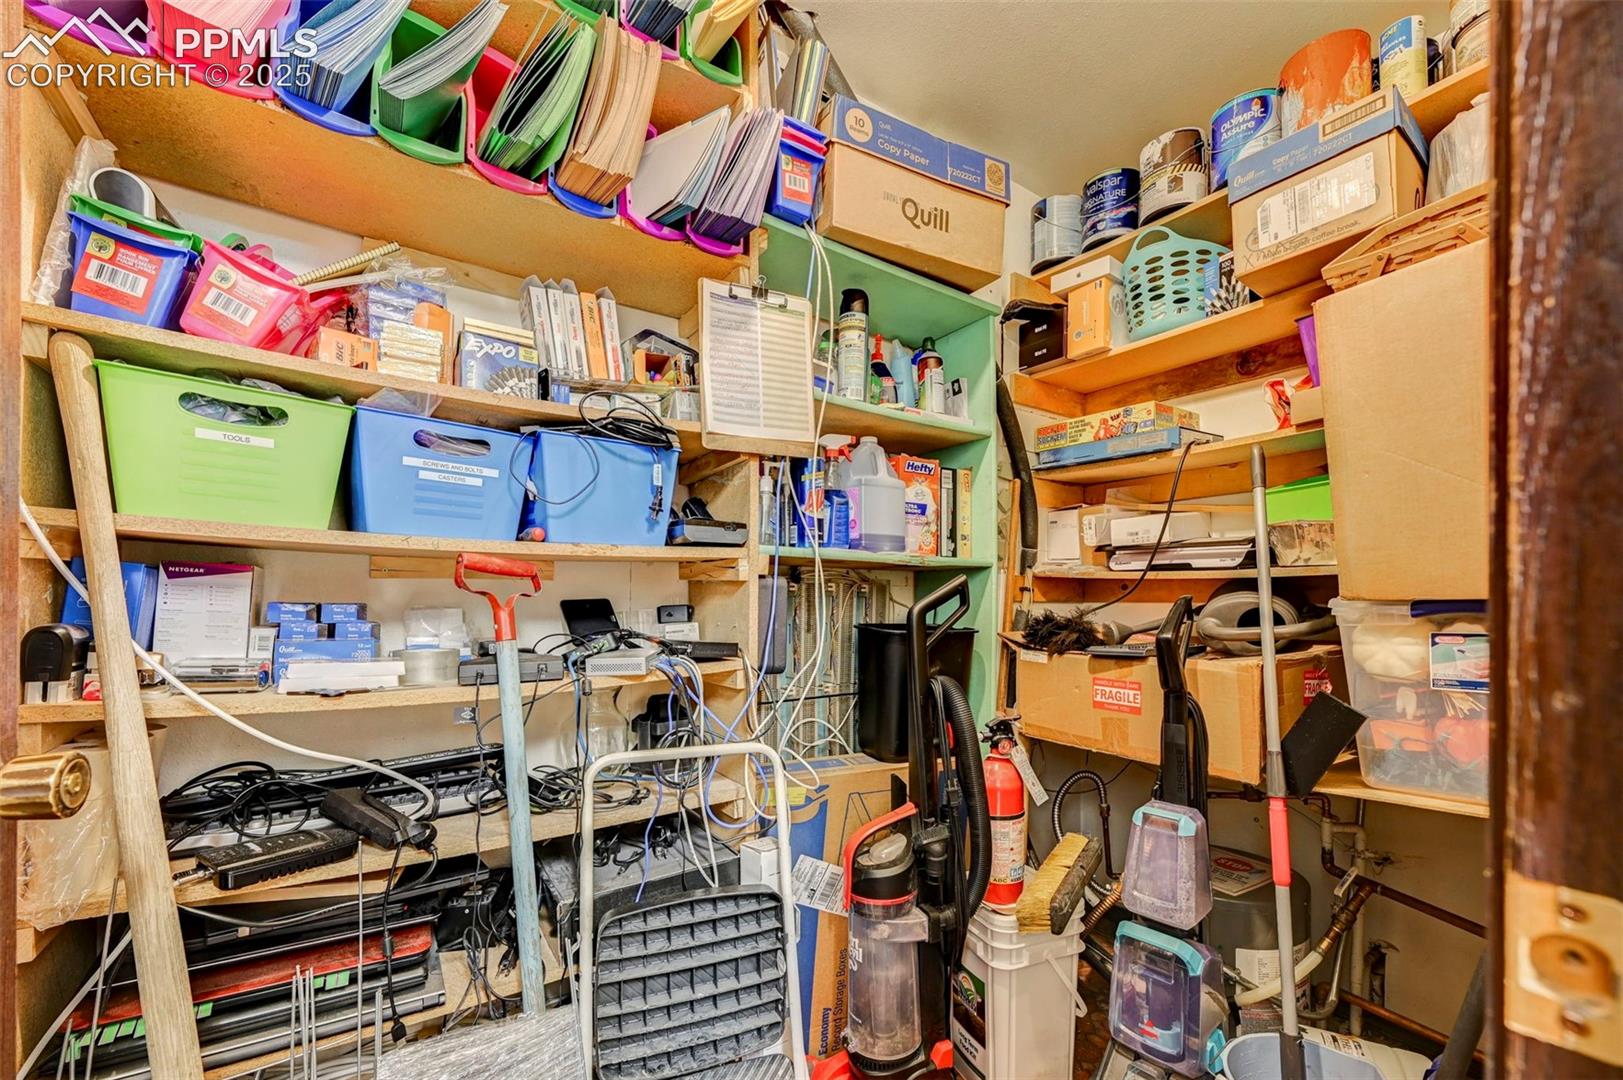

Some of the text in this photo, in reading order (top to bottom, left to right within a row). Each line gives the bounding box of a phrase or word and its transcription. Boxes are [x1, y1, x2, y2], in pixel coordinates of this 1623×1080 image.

[853, 115, 866, 128] 10
[1220, 108, 1267, 133] OLYMPIC
[877, 138, 901, 156] Copy
[903, 149, 930, 167] Paper
[1086, 175, 1123, 197] valspar
[901, 197, 950, 233] Quill
[223, 433, 251, 444] TOOLS
[422, 460, 450, 469] SCREWS
[464, 466, 484, 475] BOLTS
[906, 461, 934, 475] Hefty
[438, 474, 466, 483] CASTERS
[1094, 688, 1140, 704] FRAGILE
[1216, 858, 1251, 870] STOP
[832, 948, 848, 1052] Record Storage Boxes
[818, 1007, 832, 1056] Economy
